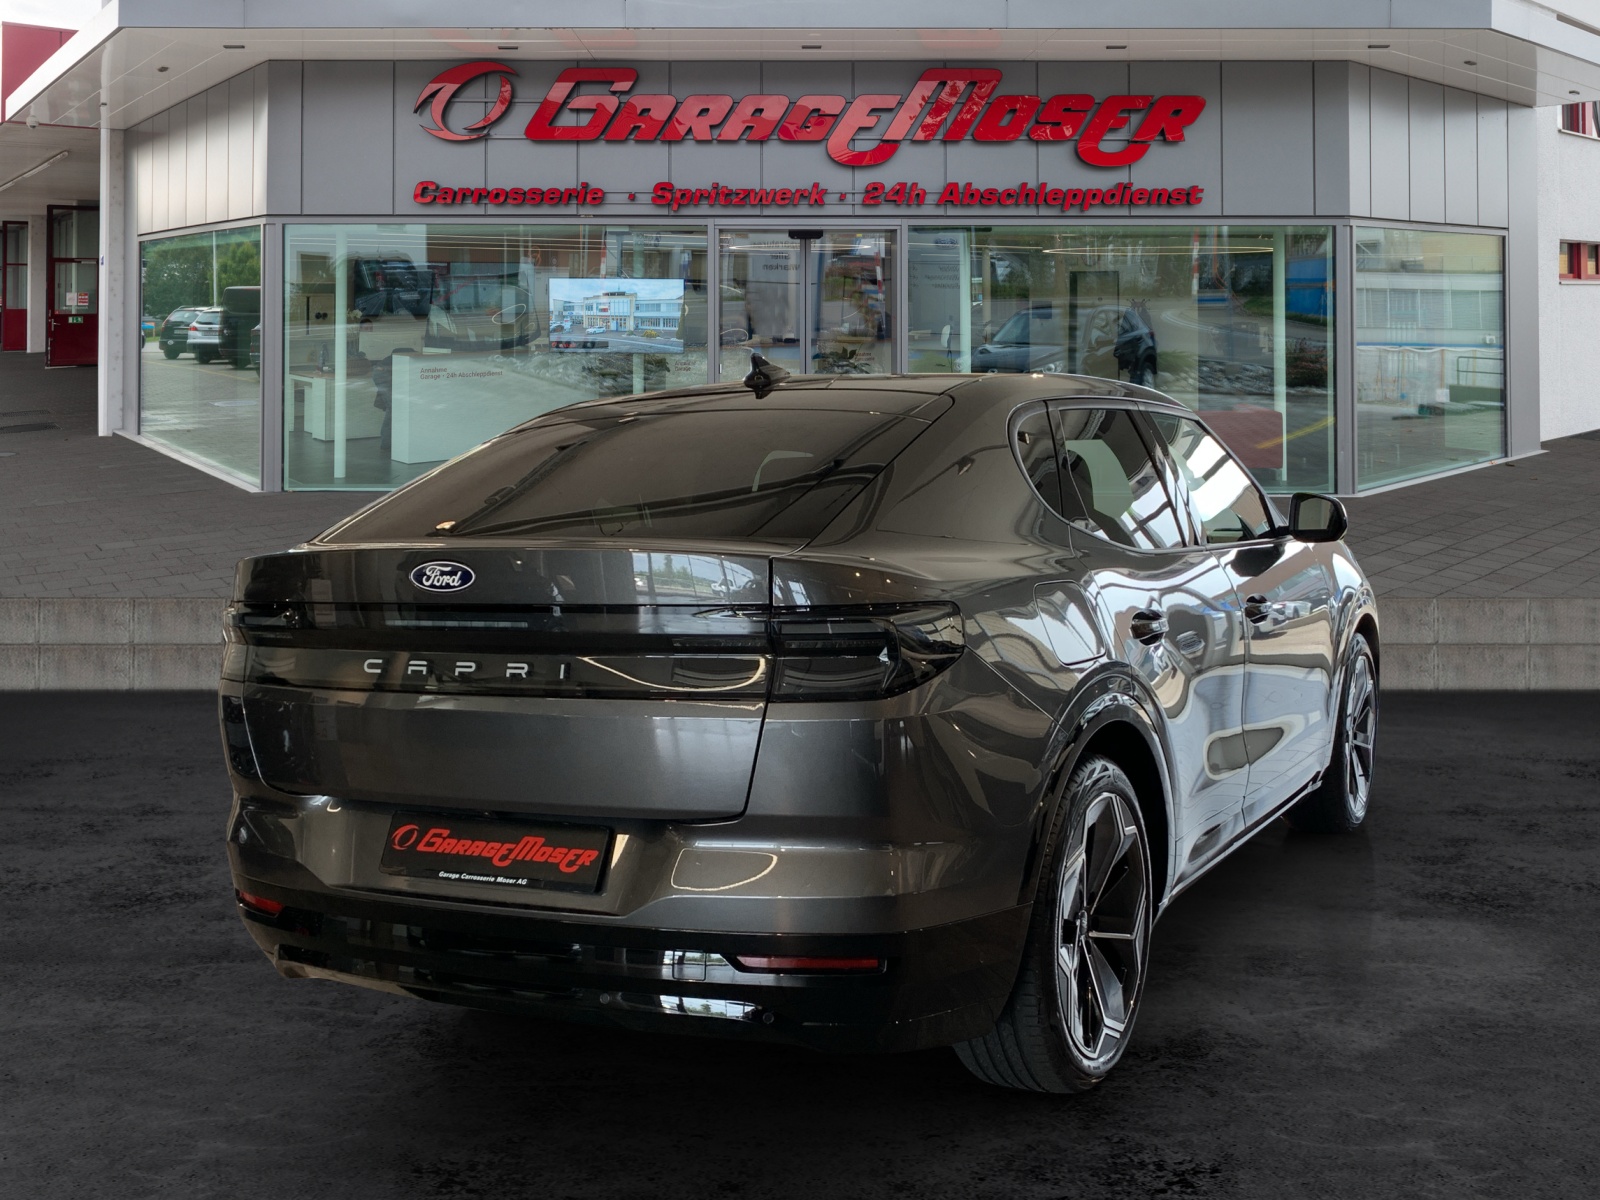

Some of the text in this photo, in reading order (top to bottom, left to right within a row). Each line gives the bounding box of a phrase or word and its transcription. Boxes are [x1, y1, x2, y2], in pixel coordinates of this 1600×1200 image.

[413, 181, 1204, 211] Carrosserie Spritzwerk 24h Abschleppdienst
[422, 565, 462, 587] Ford
[363, 659, 566, 680] CAPRI
[438, 871, 460, 880] Garage
[460, 873, 496, 882] Carrosserie
[495, 876, 516, 885] Moser
